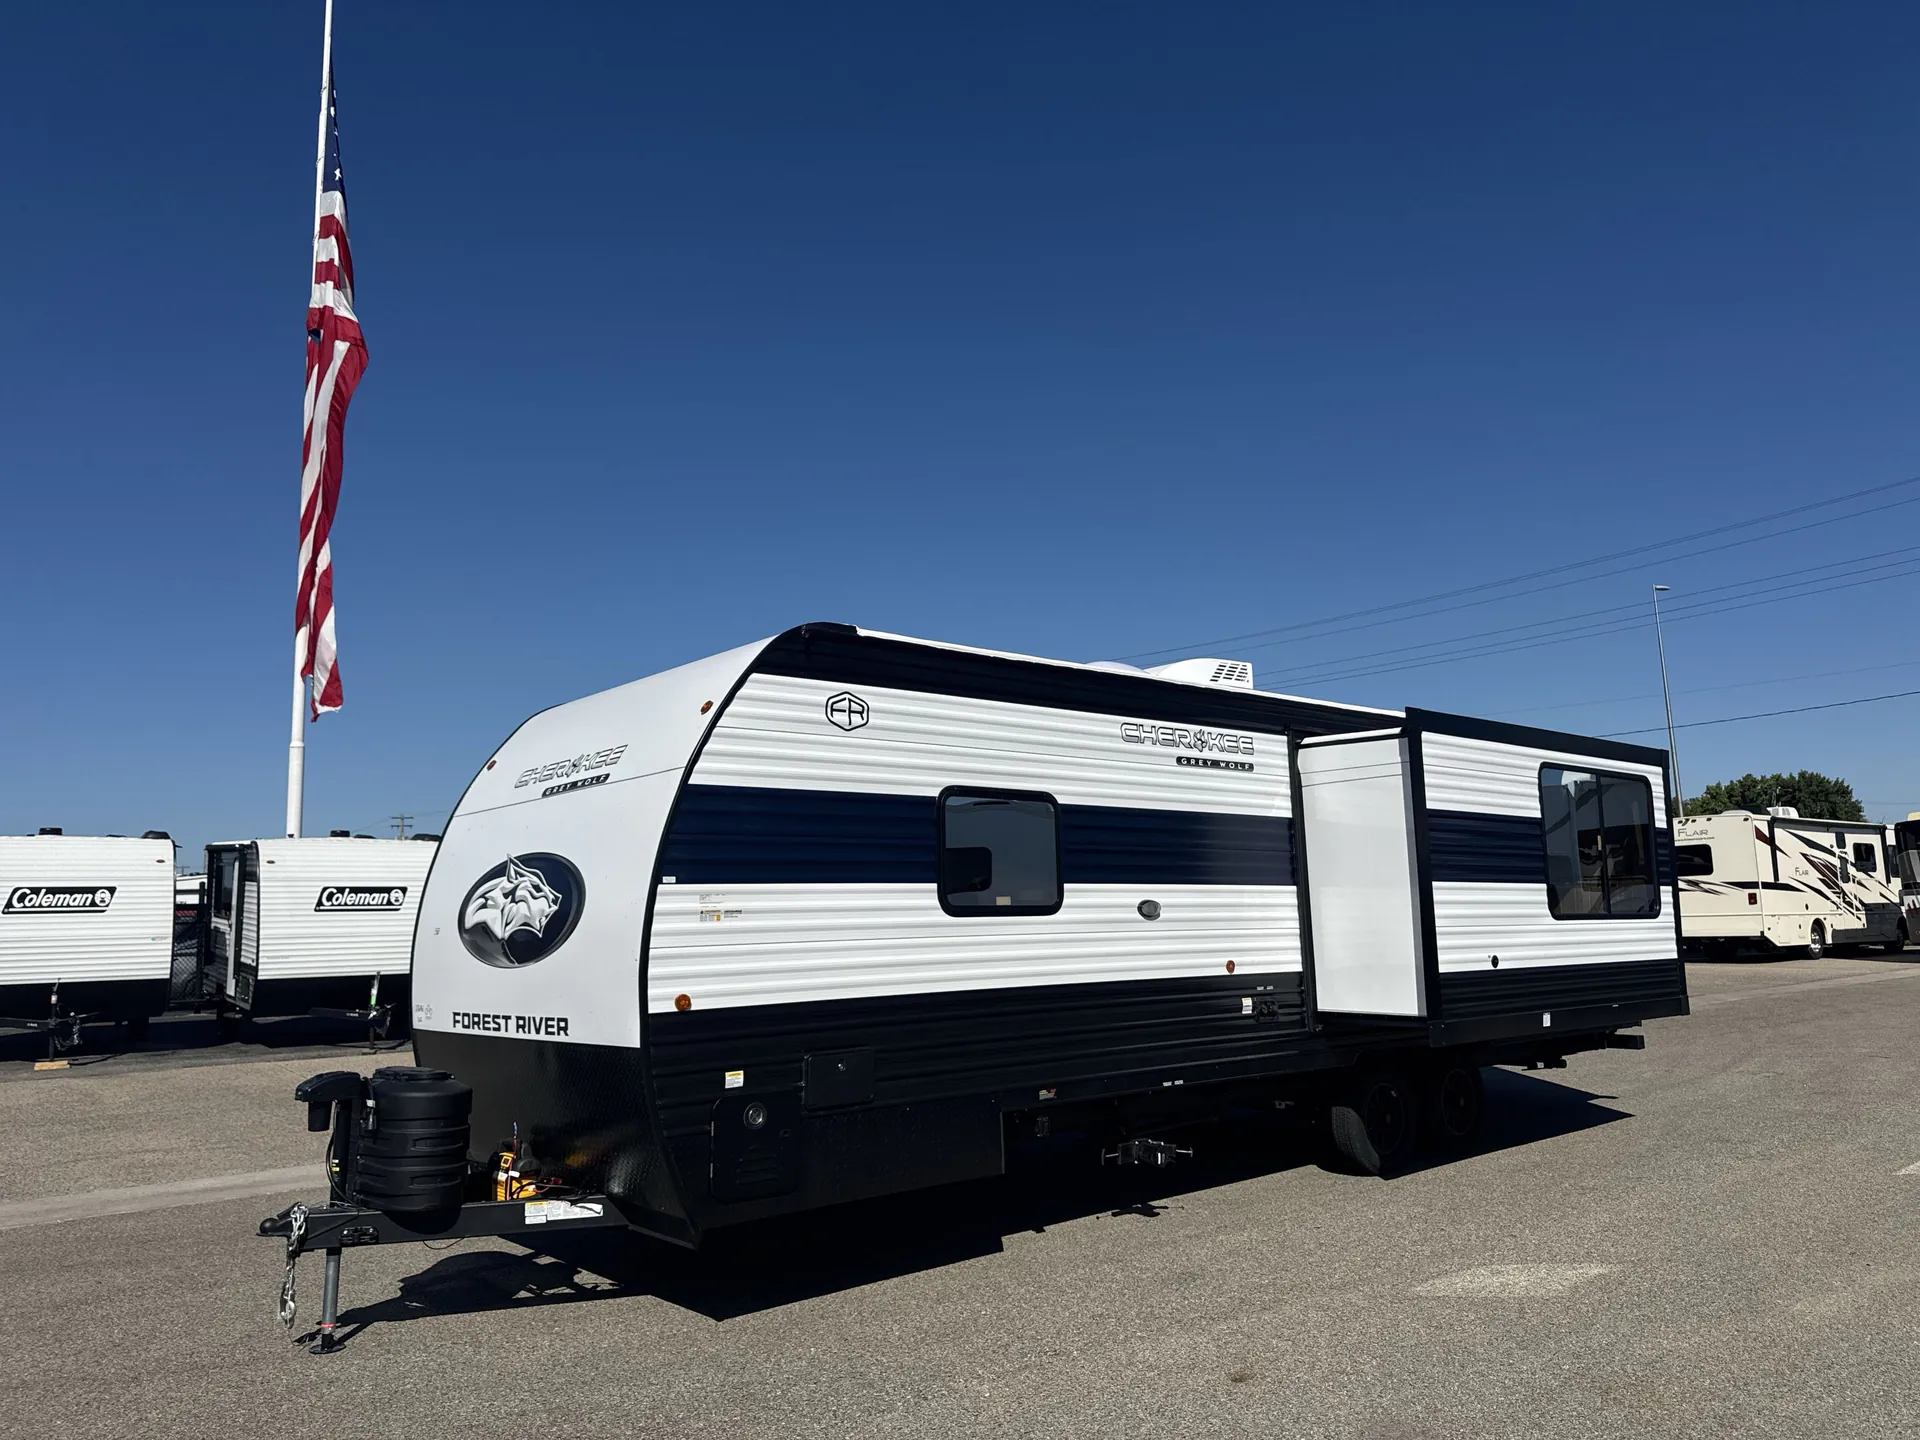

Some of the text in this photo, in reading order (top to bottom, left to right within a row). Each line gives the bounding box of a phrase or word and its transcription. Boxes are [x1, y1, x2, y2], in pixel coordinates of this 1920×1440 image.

[1181, 758, 1250, 770] GREY WOLF
[545, 775, 607, 795] GREY WOLF
[12, 888, 94, 908] Coleman
[321, 887, 389, 906] Coleman
[452, 1011, 569, 1037] FOREST RIVER
